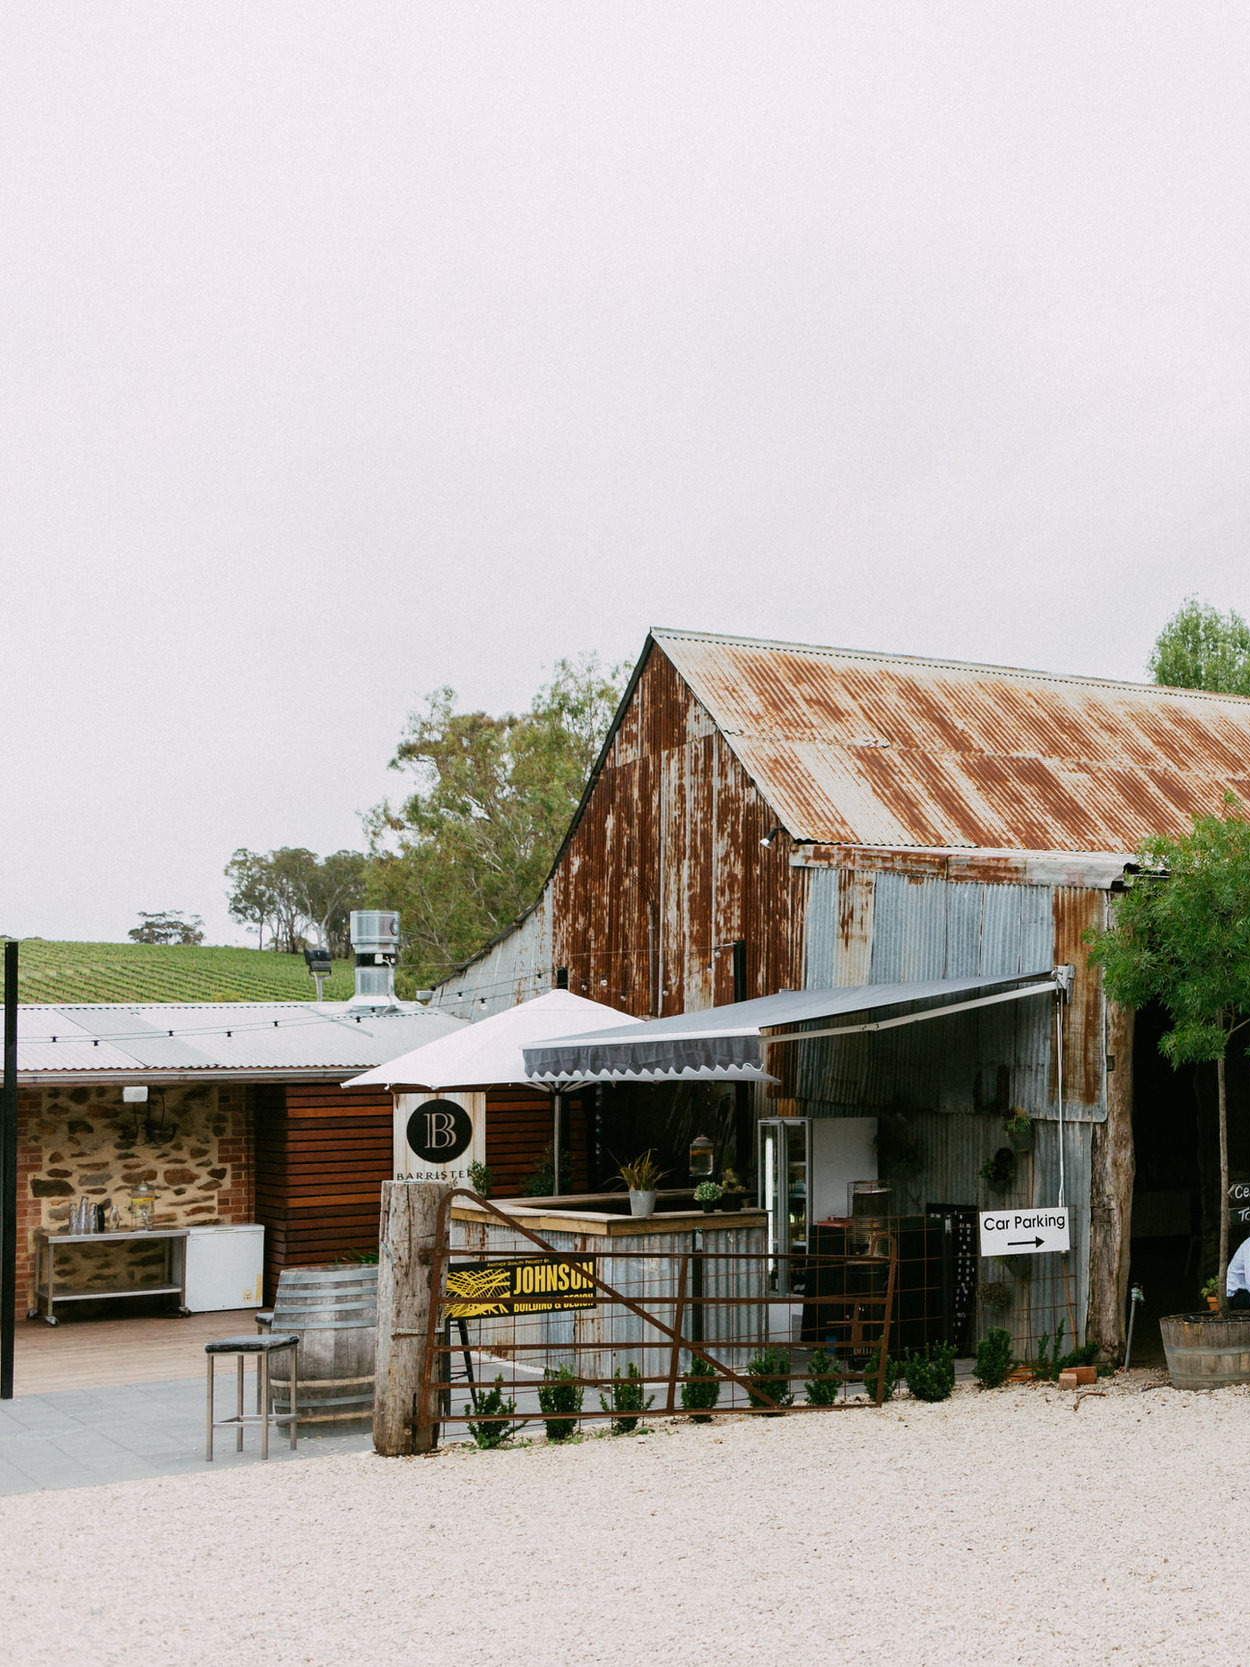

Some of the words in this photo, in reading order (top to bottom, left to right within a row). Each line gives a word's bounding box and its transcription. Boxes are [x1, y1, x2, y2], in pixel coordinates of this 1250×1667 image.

[984, 1217, 1010, 1231] Car
[1014, 1214, 1065, 1230] Parking
[513, 1261, 594, 1295] JOHNSON
